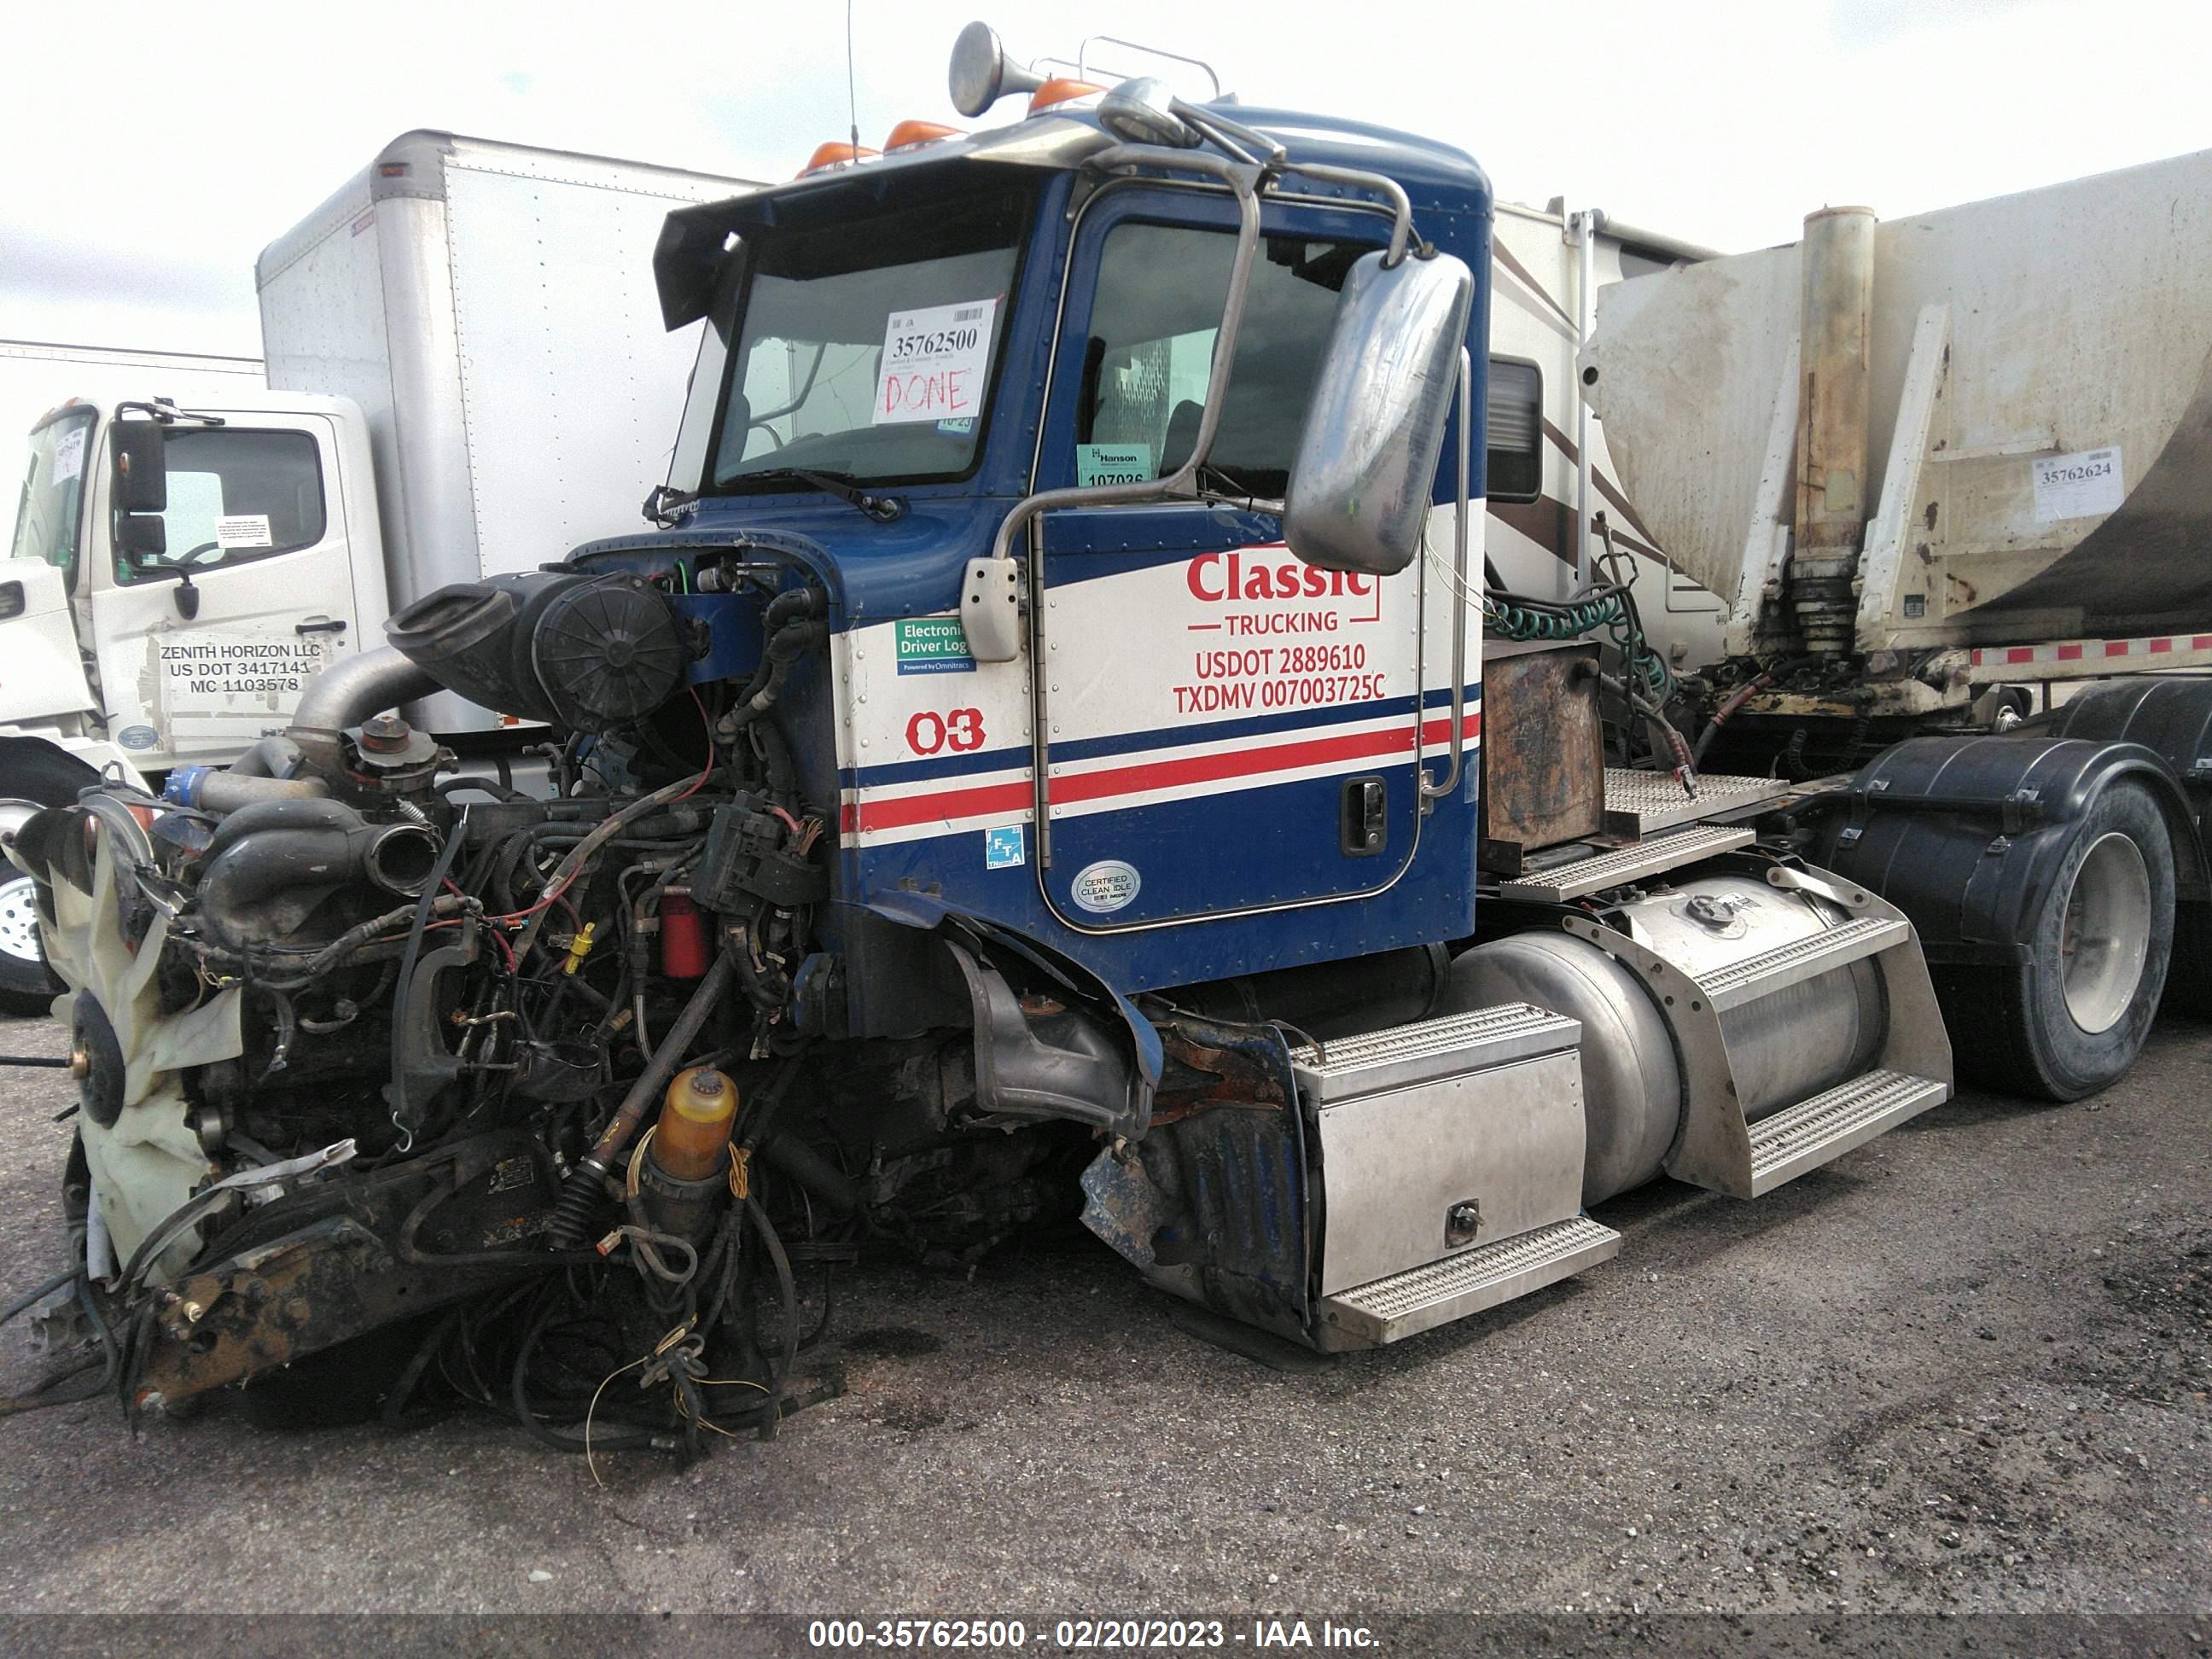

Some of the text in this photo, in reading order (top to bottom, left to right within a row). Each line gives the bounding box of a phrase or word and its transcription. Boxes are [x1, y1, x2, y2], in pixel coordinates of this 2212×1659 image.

[893, 328, 978, 358] 35762500
[886, 368, 972, 414] DONE
[1100, 454, 1137, 463] Hanson
[2042, 462, 2111, 485] 35762624
[1186, 552, 1372, 602] Classic
[1225, 611, 1339, 637] TRUCKING
[160, 643, 321, 660] ZENITH HORIZON LLC
[901, 640, 941, 654] Driver
[170, 661, 311, 677] US DOT 3417141
[934, 661, 969, 671] Omnitracs
[1196, 643, 1365, 679] USDOT 2889610
[190, 678, 299, 694] MC 1103578
[1173, 673, 1386, 714] TXDMV 007003725C
[905, 707, 987, 756] 03
[1080, 886, 1110, 896] CLEAN
[1113, 882, 1132, 892] IDLE
[1085, 875, 1127, 887] CERTIFIED
